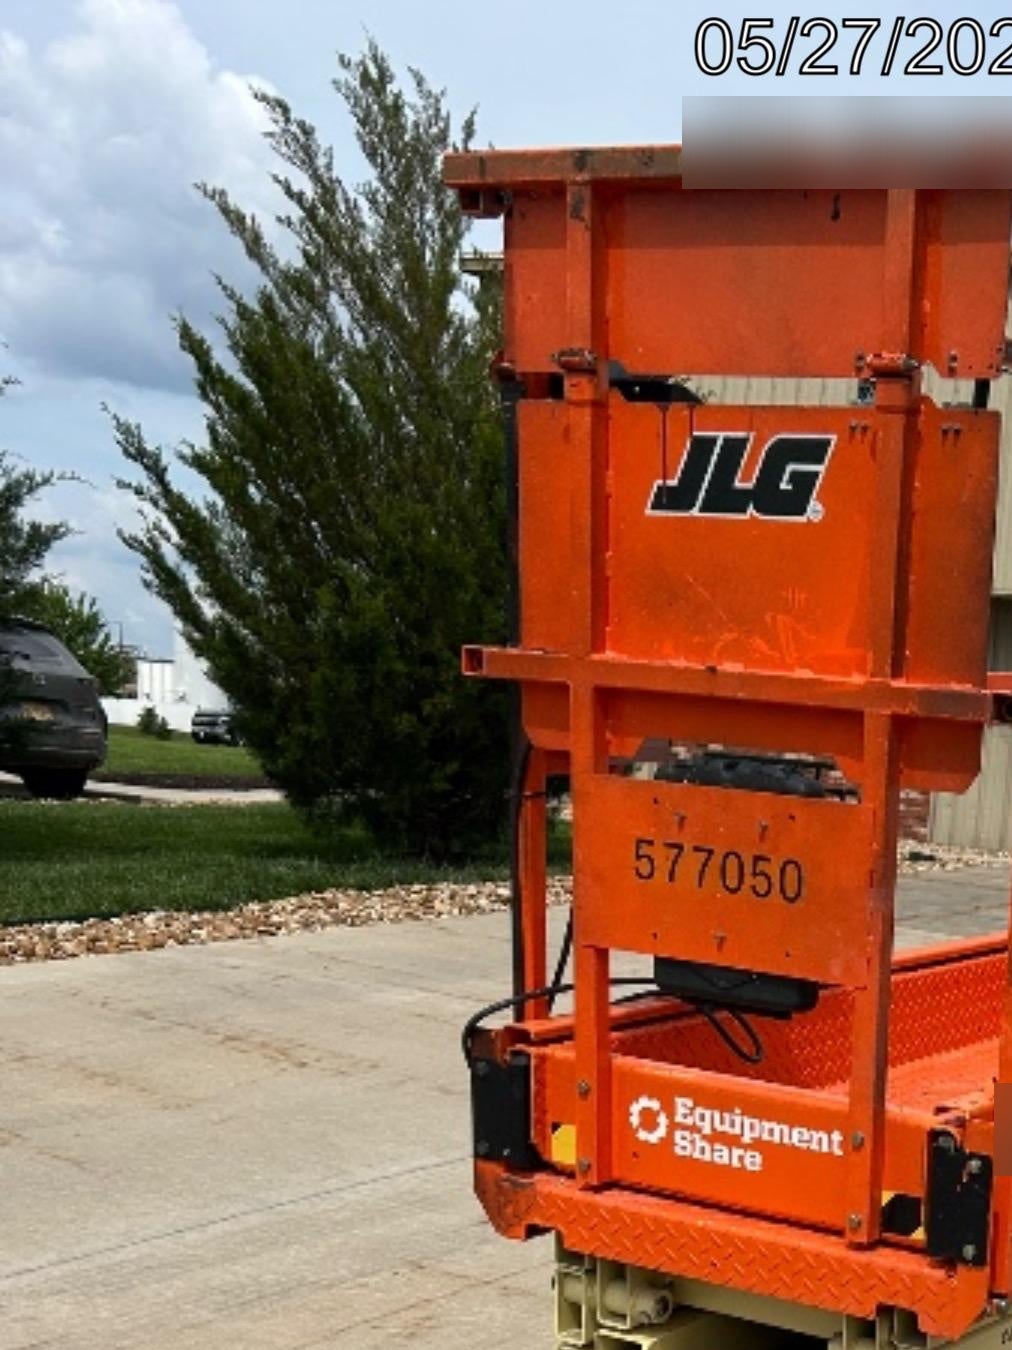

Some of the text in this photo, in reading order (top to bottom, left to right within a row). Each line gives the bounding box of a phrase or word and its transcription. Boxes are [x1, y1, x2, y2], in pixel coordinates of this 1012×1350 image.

[645, 432, 837, 522] JLG
[634, 838, 804, 904] 577050
[673, 1096, 844, 1156] Equipment
[673, 1129, 763, 1171] Share
